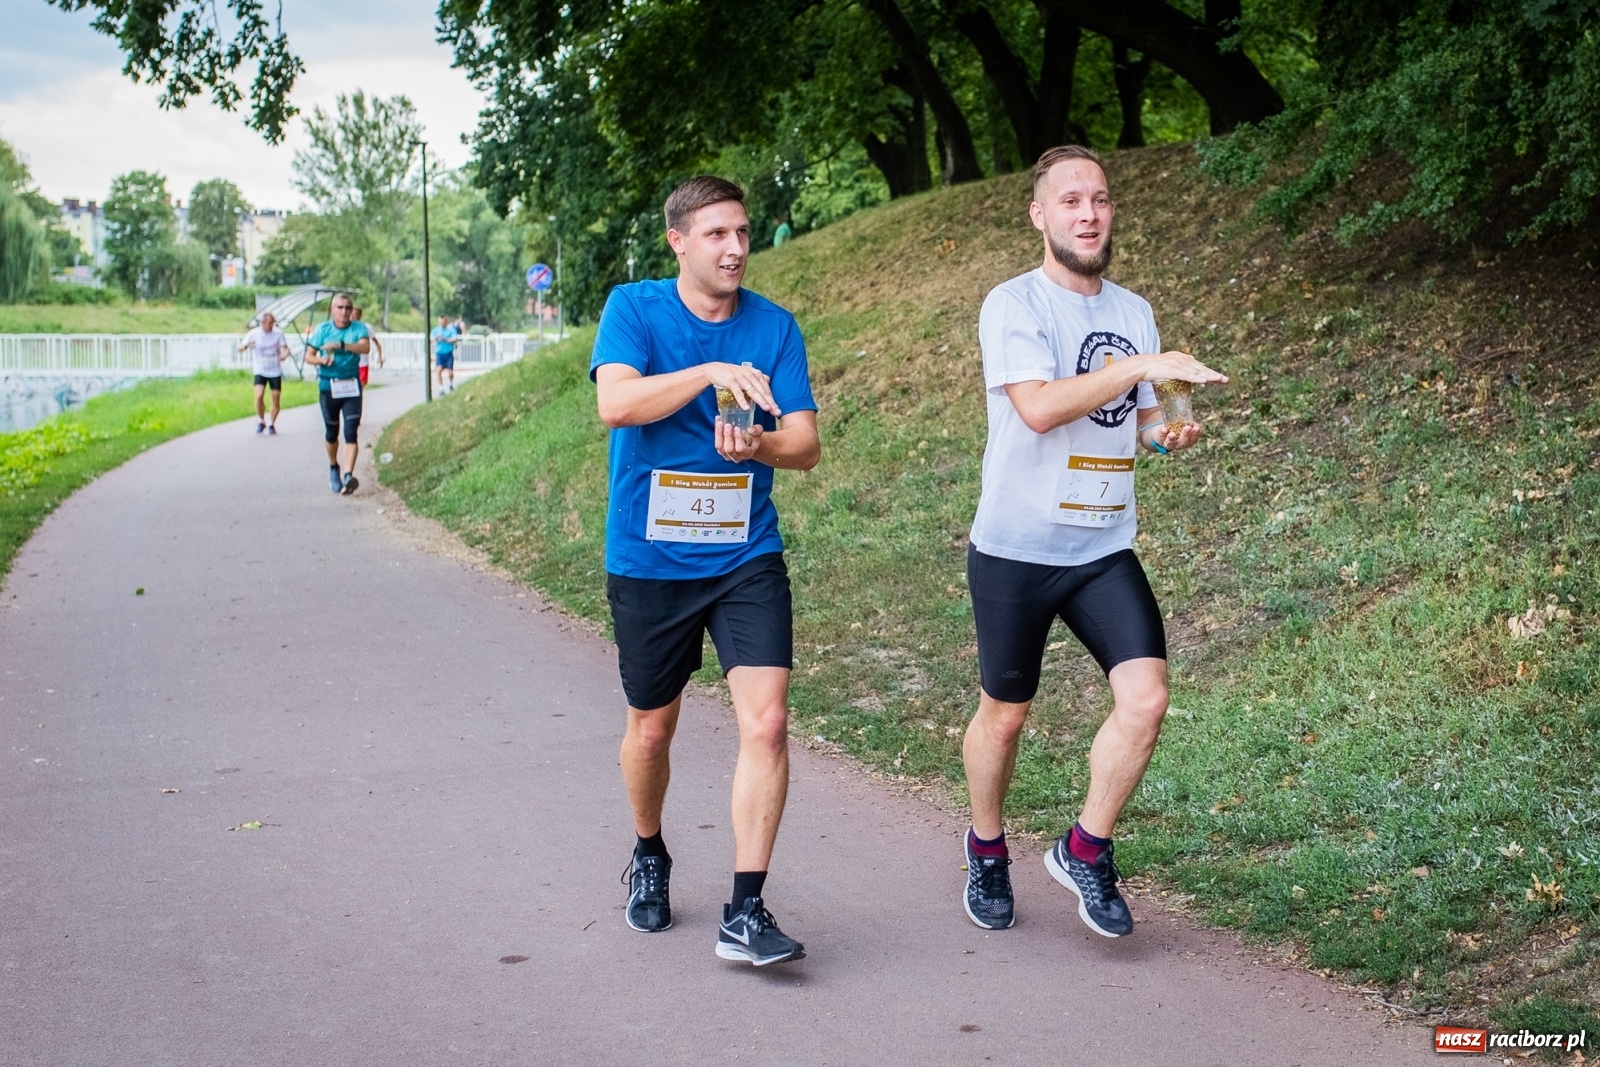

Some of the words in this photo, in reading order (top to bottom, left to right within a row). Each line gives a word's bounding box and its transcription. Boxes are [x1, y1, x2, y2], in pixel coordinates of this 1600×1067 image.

[1081, 335, 1108, 370] BIEGAM
[1082, 461, 1096, 470] Bieg
[675, 479, 690, 487] Bieg
[1100, 481, 1110, 499] 7
[690, 498, 716, 516] 43
